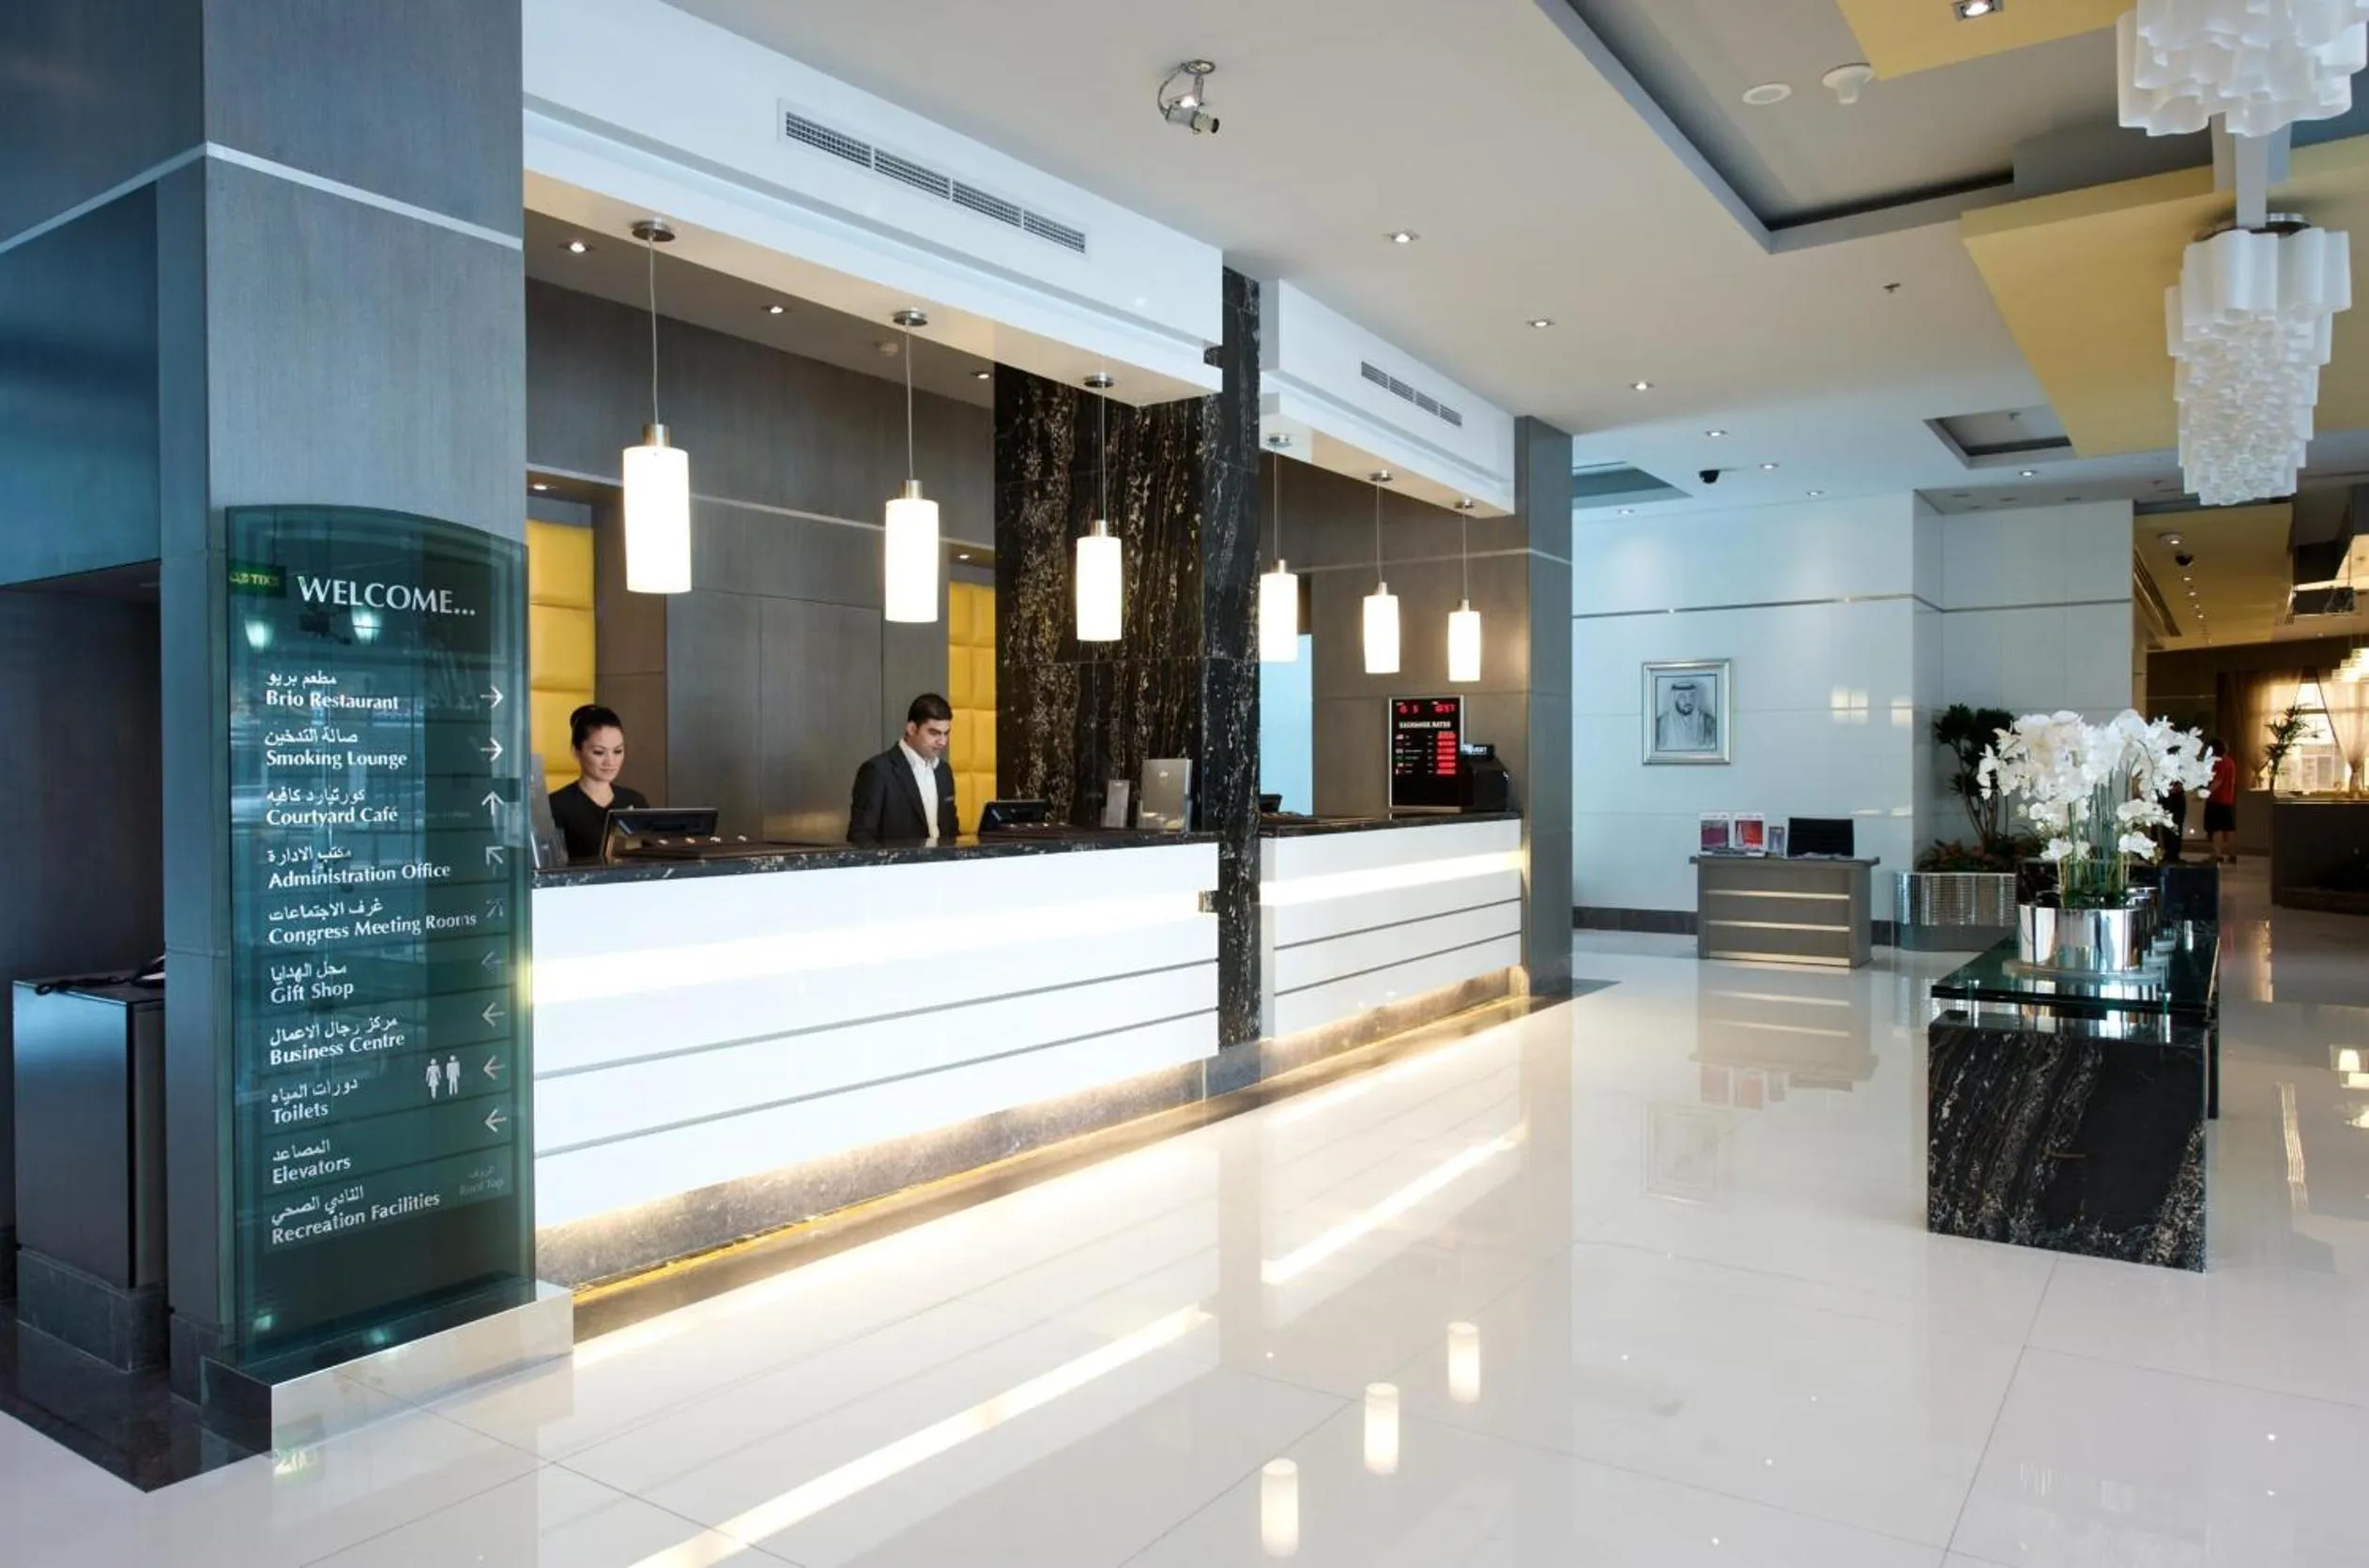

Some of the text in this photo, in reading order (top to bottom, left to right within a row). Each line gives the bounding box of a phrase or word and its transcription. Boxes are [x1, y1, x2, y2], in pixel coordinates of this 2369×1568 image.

[297, 575, 476, 616] WELCOME...
[266, 670, 338, 689] مطعم بريو
[266, 689, 399, 710] Brio Restaurant
[265, 725, 359, 746] صالة التدخين
[267, 749, 408, 770] Smoking Lounge
[266, 806, 399, 828] Courtyard Café
[317, 846, 352, 862] مكتب
[267, 862, 451, 890] Administration Office
[267, 898, 384, 922] غرف الاجتماعات
[268, 914, 478, 946] Congress Meeting Rooms
[270, 961, 347, 985] محل الهدايا
[270, 981, 354, 1003] Gift Shop
[324, 1022, 360, 1038] رجال
[365, 1015, 399, 1033] مركز
[269, 1032, 405, 1066] Business Centre
[270, 1078, 359, 1105] دورات المياه
[271, 1102, 329, 1125] Toilets
[271, 1138, 330, 1163] المصاعد
[272, 1155, 352, 1184] Elevators
[270, 1184, 364, 1225] النادي الصحي
[271, 1192, 440, 1245] Recreation Facilities
